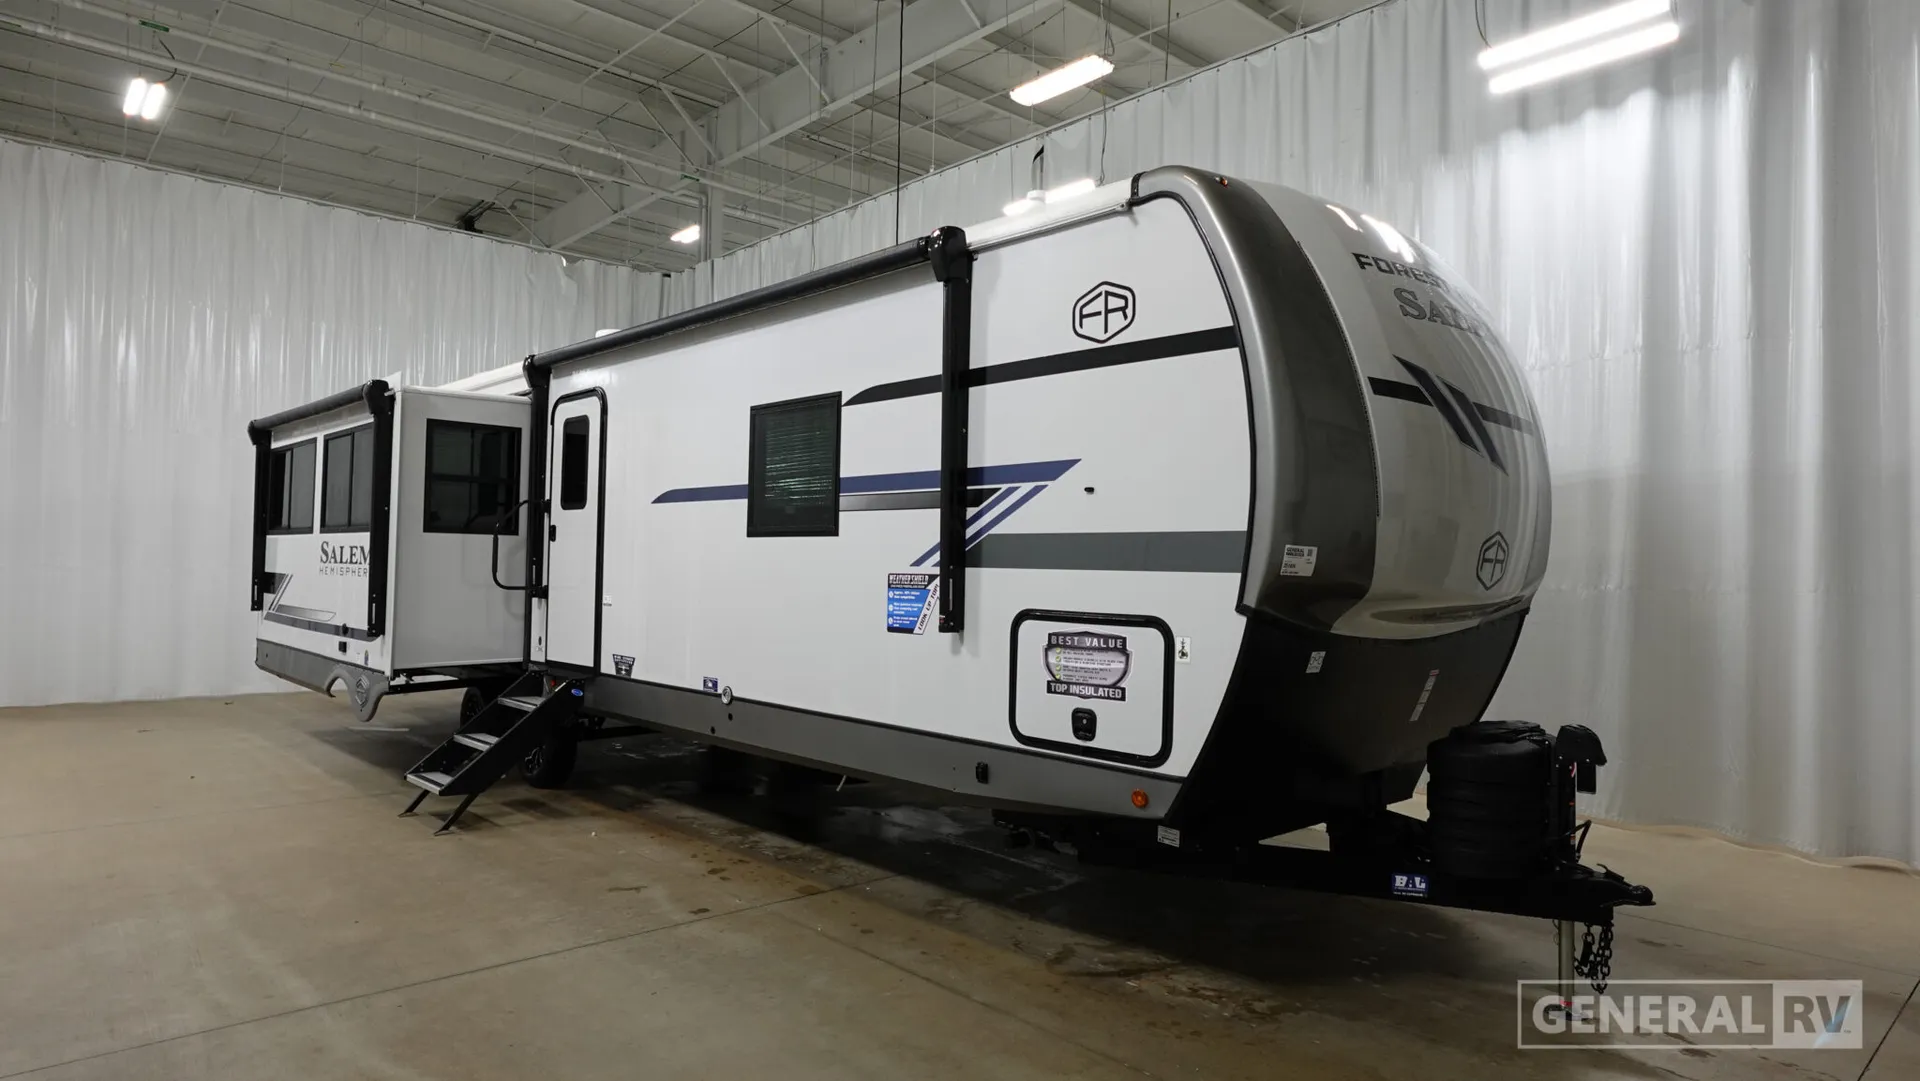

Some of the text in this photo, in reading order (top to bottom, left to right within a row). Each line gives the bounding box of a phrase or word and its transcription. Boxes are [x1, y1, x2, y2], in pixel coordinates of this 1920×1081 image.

[1393, 287, 1486, 338] SAL
[320, 541, 370, 565] SALEM
[319, 566, 368, 577] HEMISPHER
[1051, 635, 1123, 648] BEST VALUE
[1050, 683, 1122, 699] TOP INSULATED
